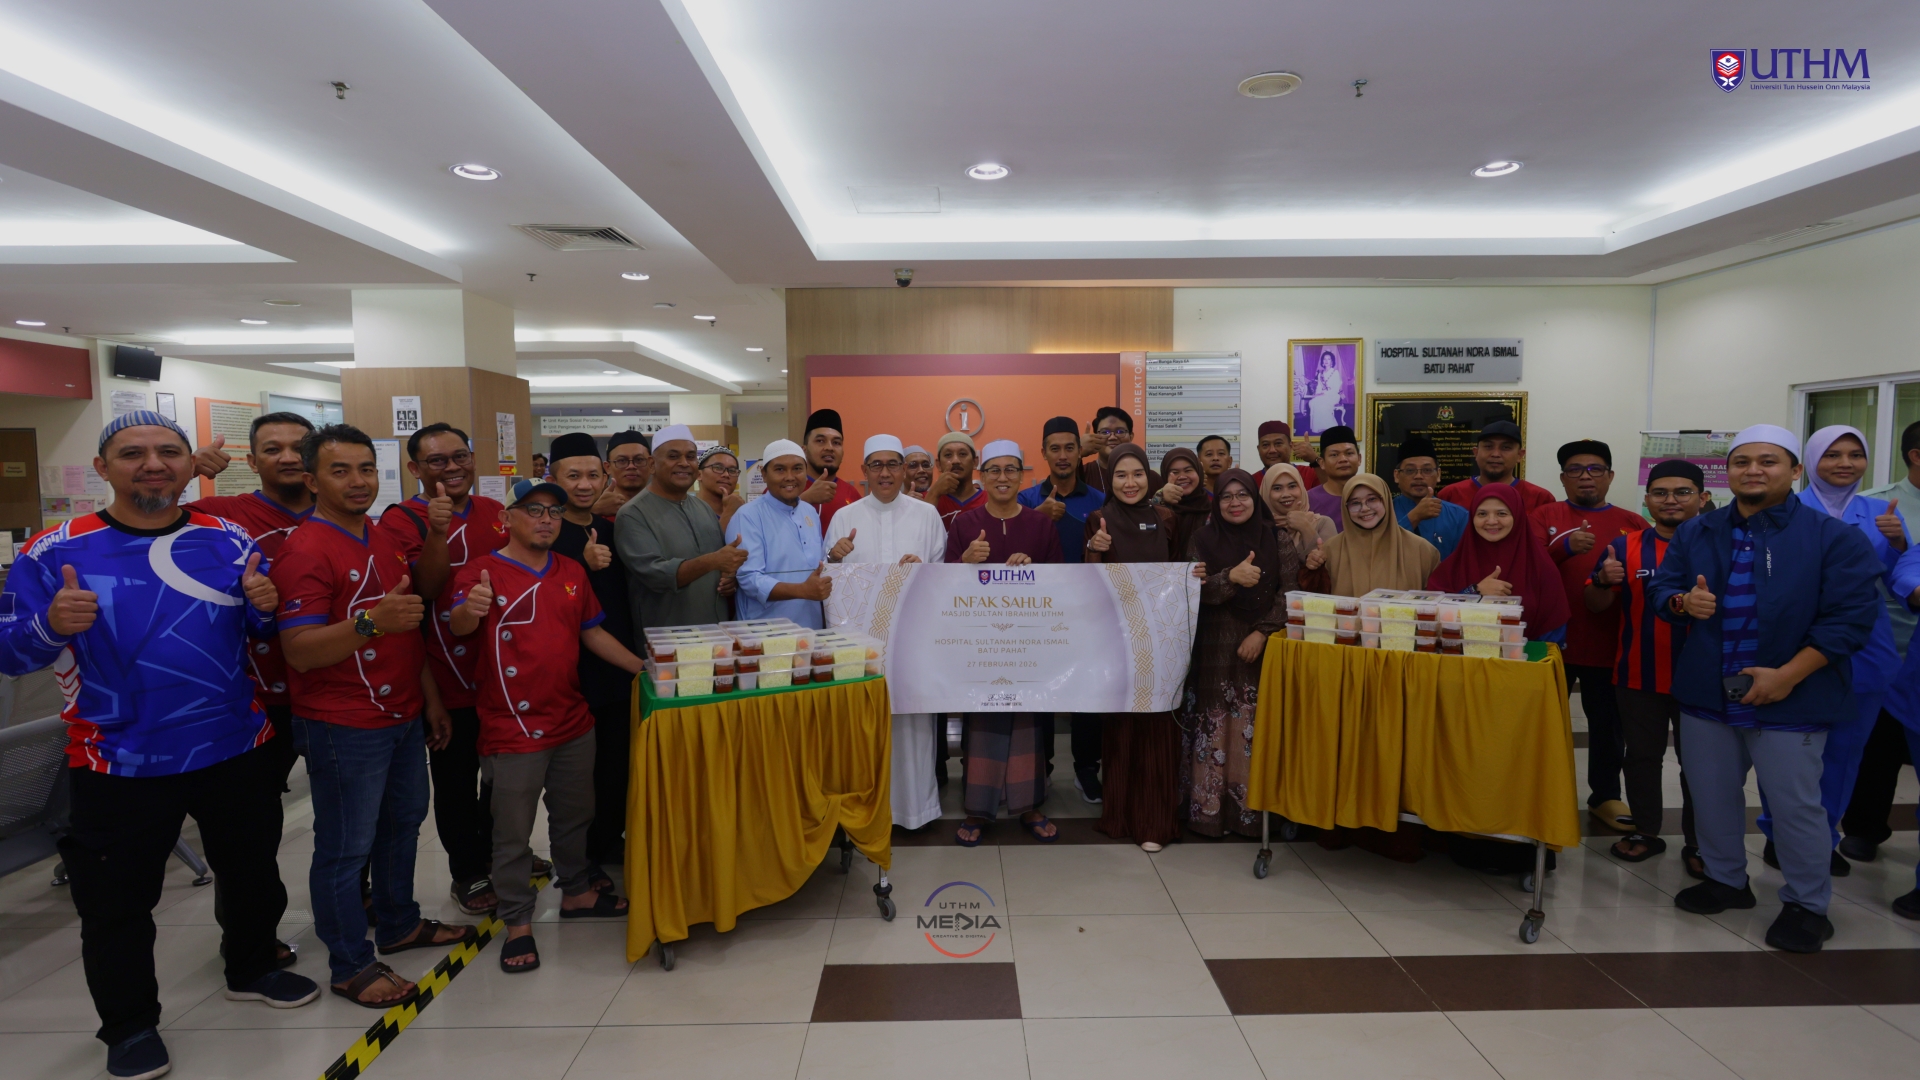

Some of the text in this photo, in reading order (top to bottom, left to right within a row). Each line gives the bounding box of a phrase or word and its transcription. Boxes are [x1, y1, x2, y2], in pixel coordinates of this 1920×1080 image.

[1381, 346, 1519, 358] HOSPITAL SULTANAH NORA ISMAIL
[1424, 363, 1475, 374] BATU PAHAT
[1134, 355, 1142, 416] DIREKTORI
[992, 570, 1035, 581] UTHM
[953, 595, 1053, 608] INFAK SAHUR
